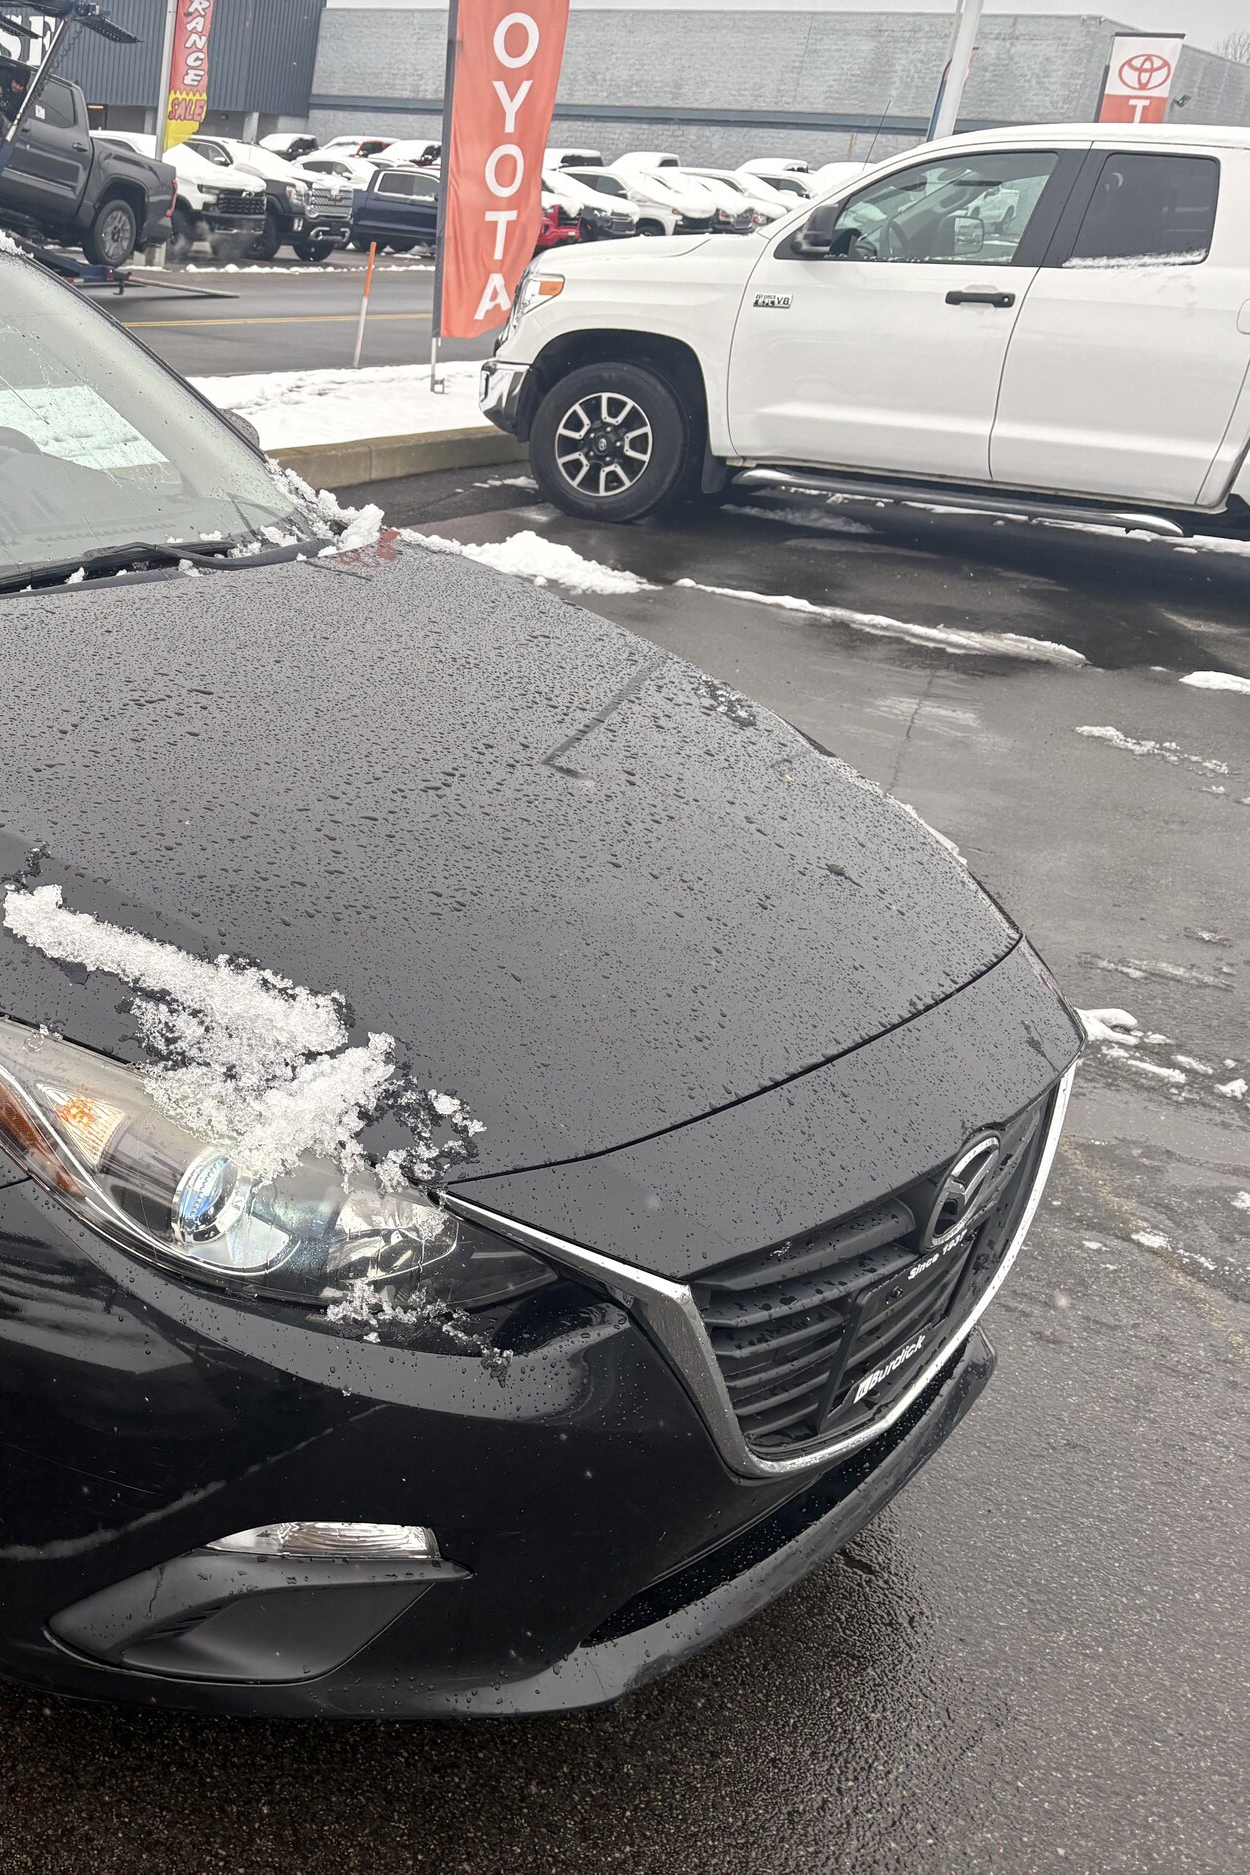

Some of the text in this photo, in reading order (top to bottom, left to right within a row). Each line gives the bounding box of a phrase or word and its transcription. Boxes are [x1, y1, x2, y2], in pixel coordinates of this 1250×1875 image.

[168, 97, 206, 121] SALE
[907, 1253, 940, 1281] Since
[868, 1334, 927, 1391] Burdick
